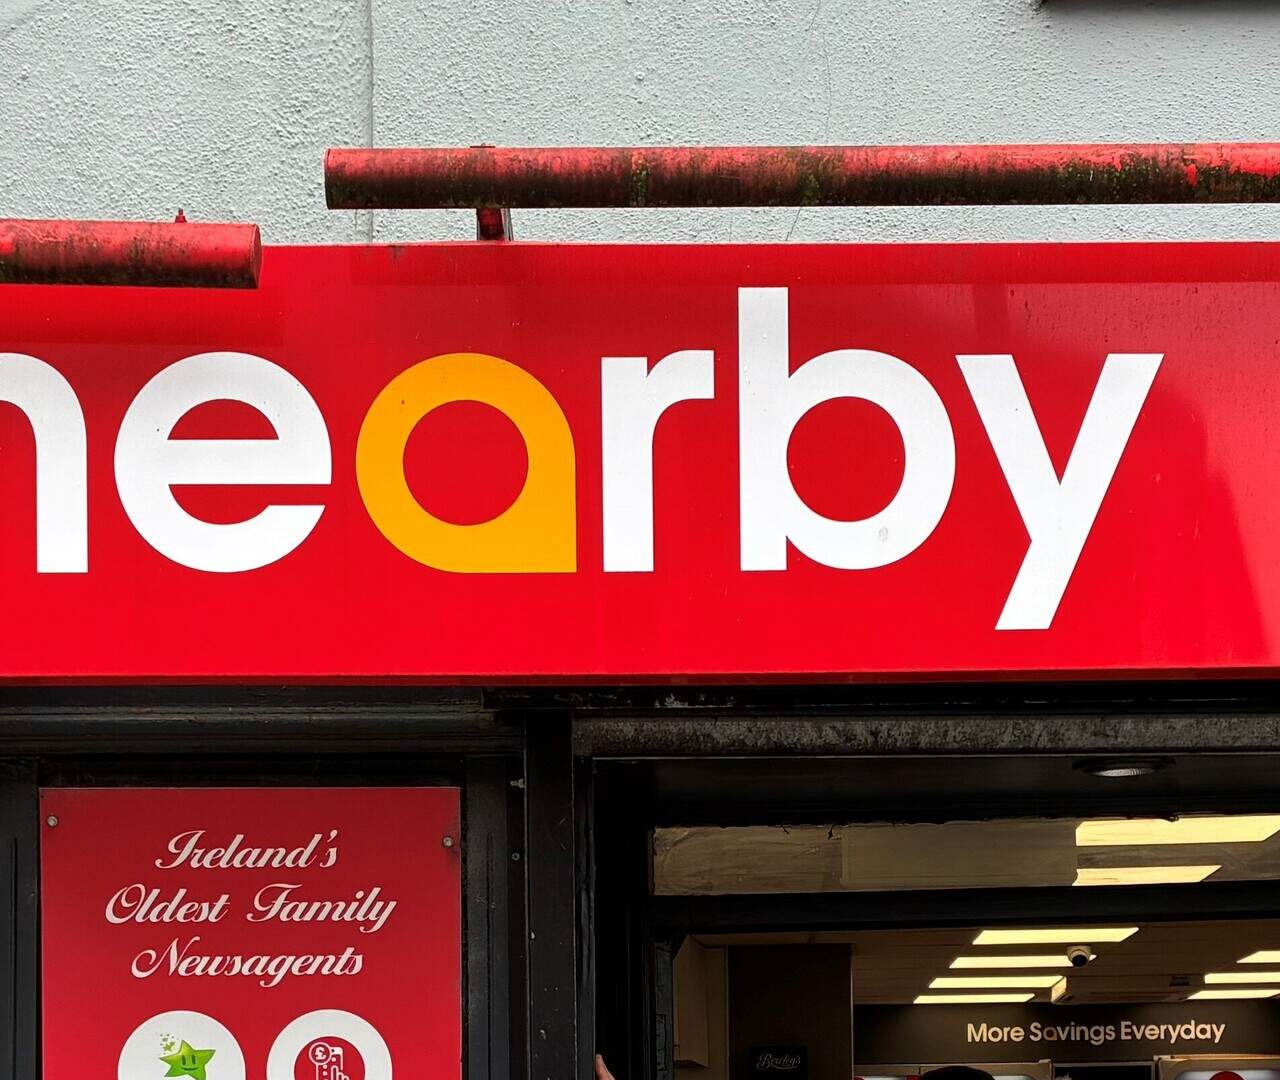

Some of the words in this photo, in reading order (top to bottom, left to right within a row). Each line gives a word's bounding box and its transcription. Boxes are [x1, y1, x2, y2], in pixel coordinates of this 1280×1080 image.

[155, 829, 339, 869] Ireland's
[105, 883, 230, 924] Oldest
[246, 883, 397, 933] Family
[131, 936, 365, 988] Newsagents
[966, 1021, 1024, 1043] More
[1029, 1021, 1116, 1047] Savings
[1120, 1019, 1226, 1046] Everyday
